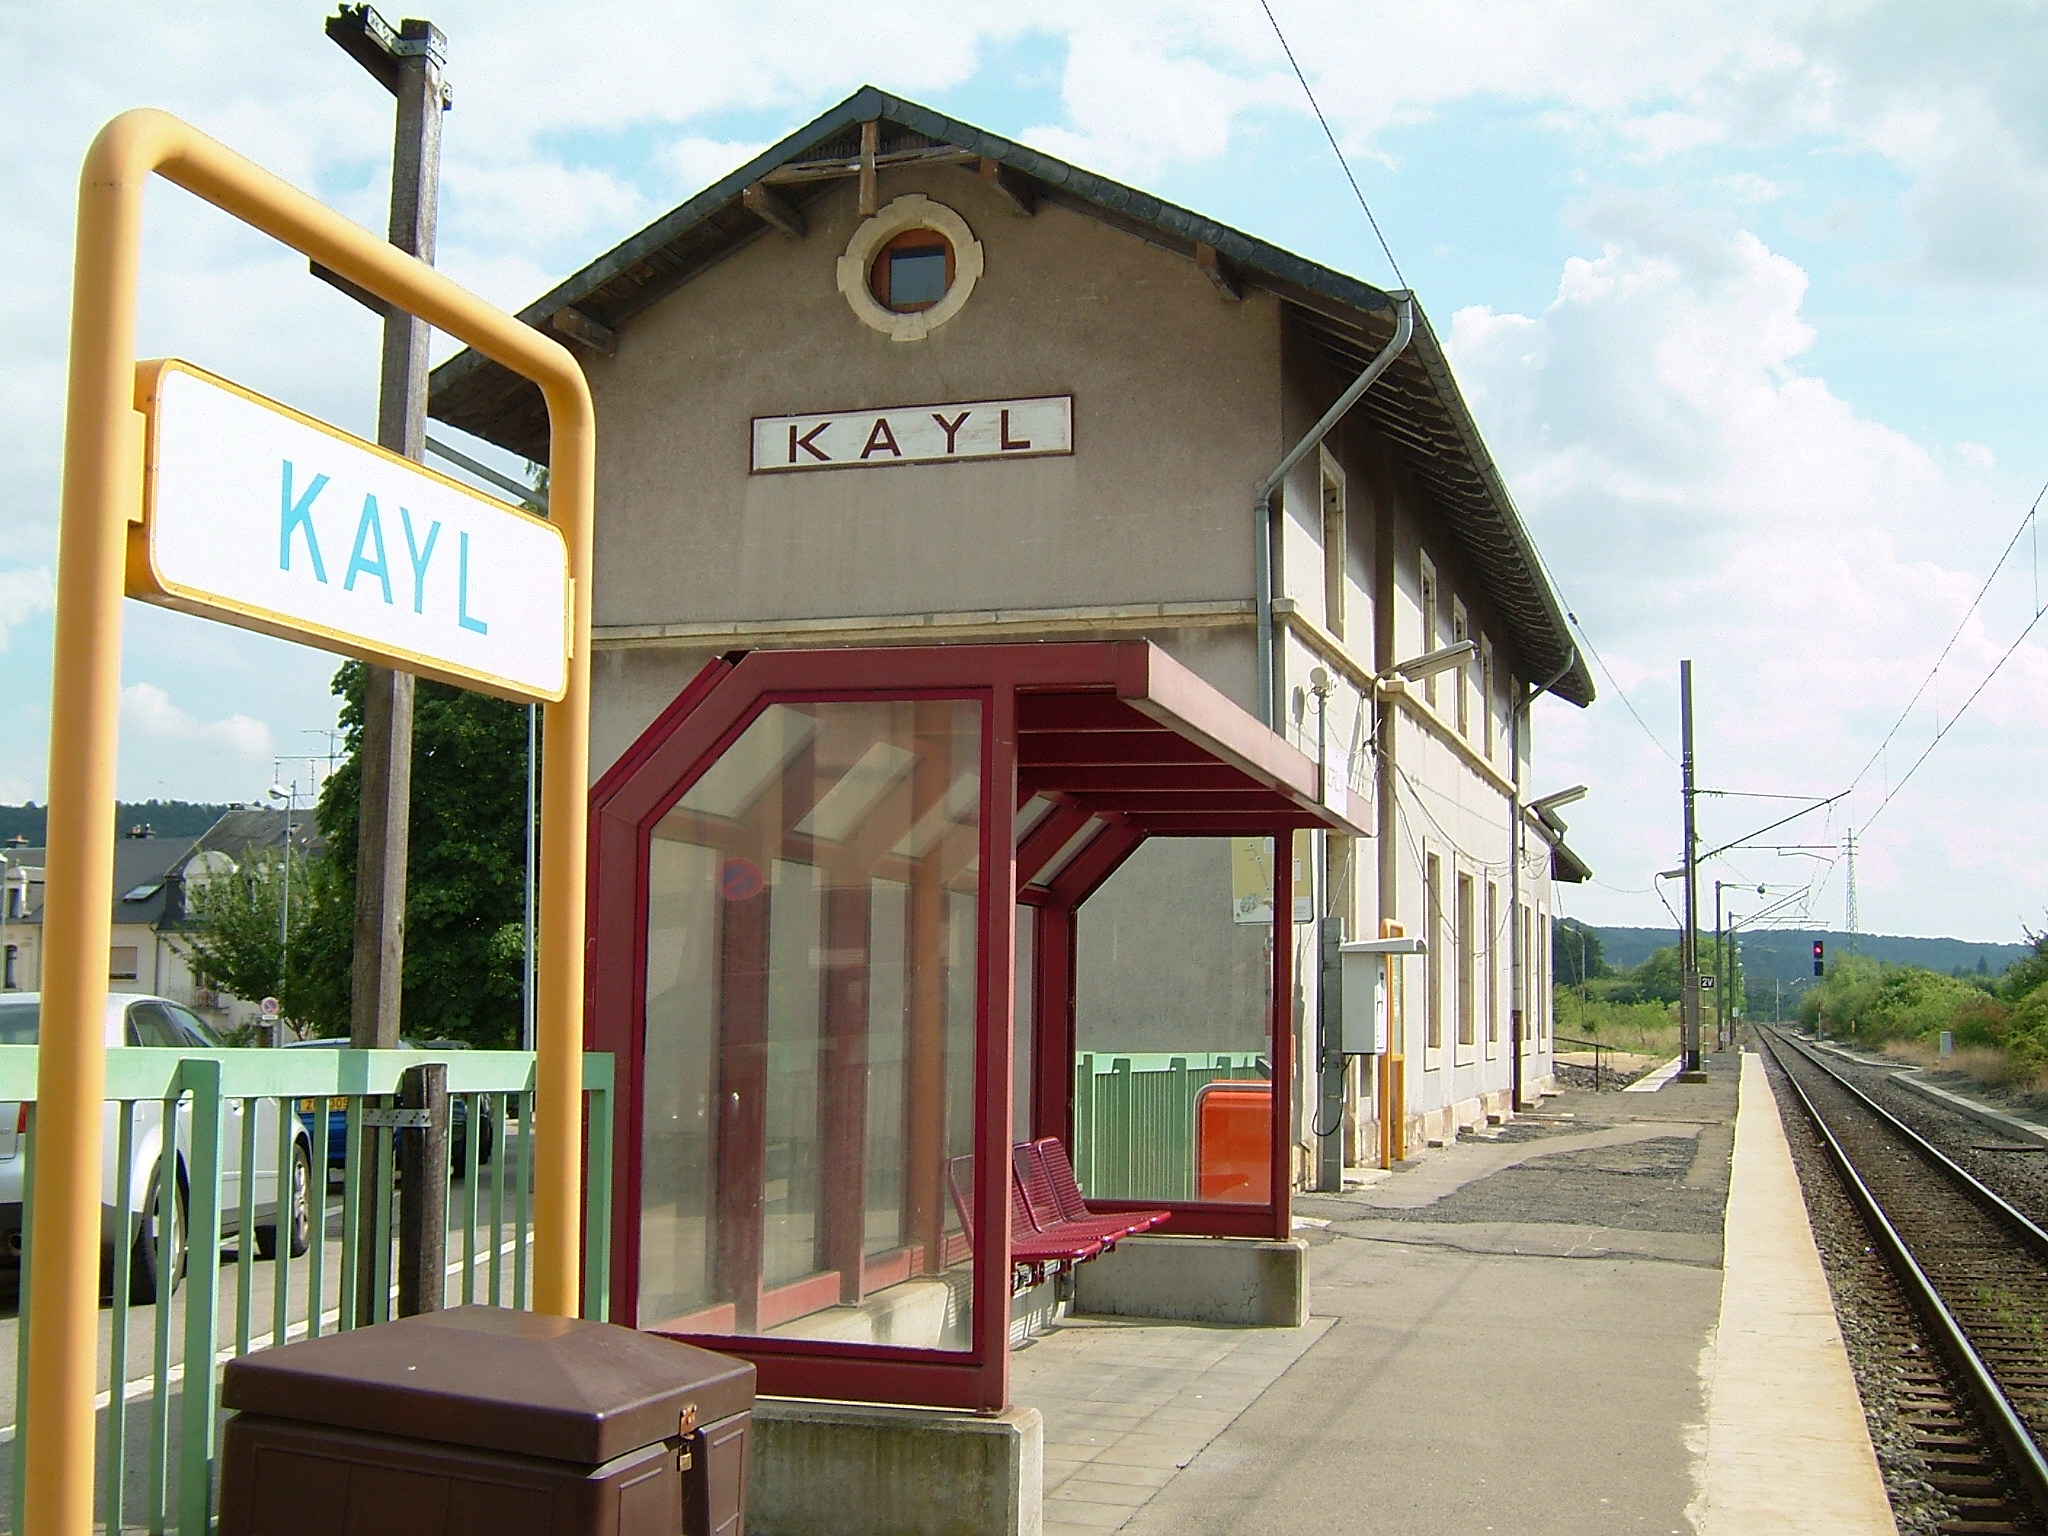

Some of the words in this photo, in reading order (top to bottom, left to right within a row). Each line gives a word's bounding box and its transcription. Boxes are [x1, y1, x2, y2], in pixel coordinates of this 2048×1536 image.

[788, 409, 1031, 463] KAYL
[280, 458, 488, 635] KAYL
[1701, 977, 1714, 987] 2V
